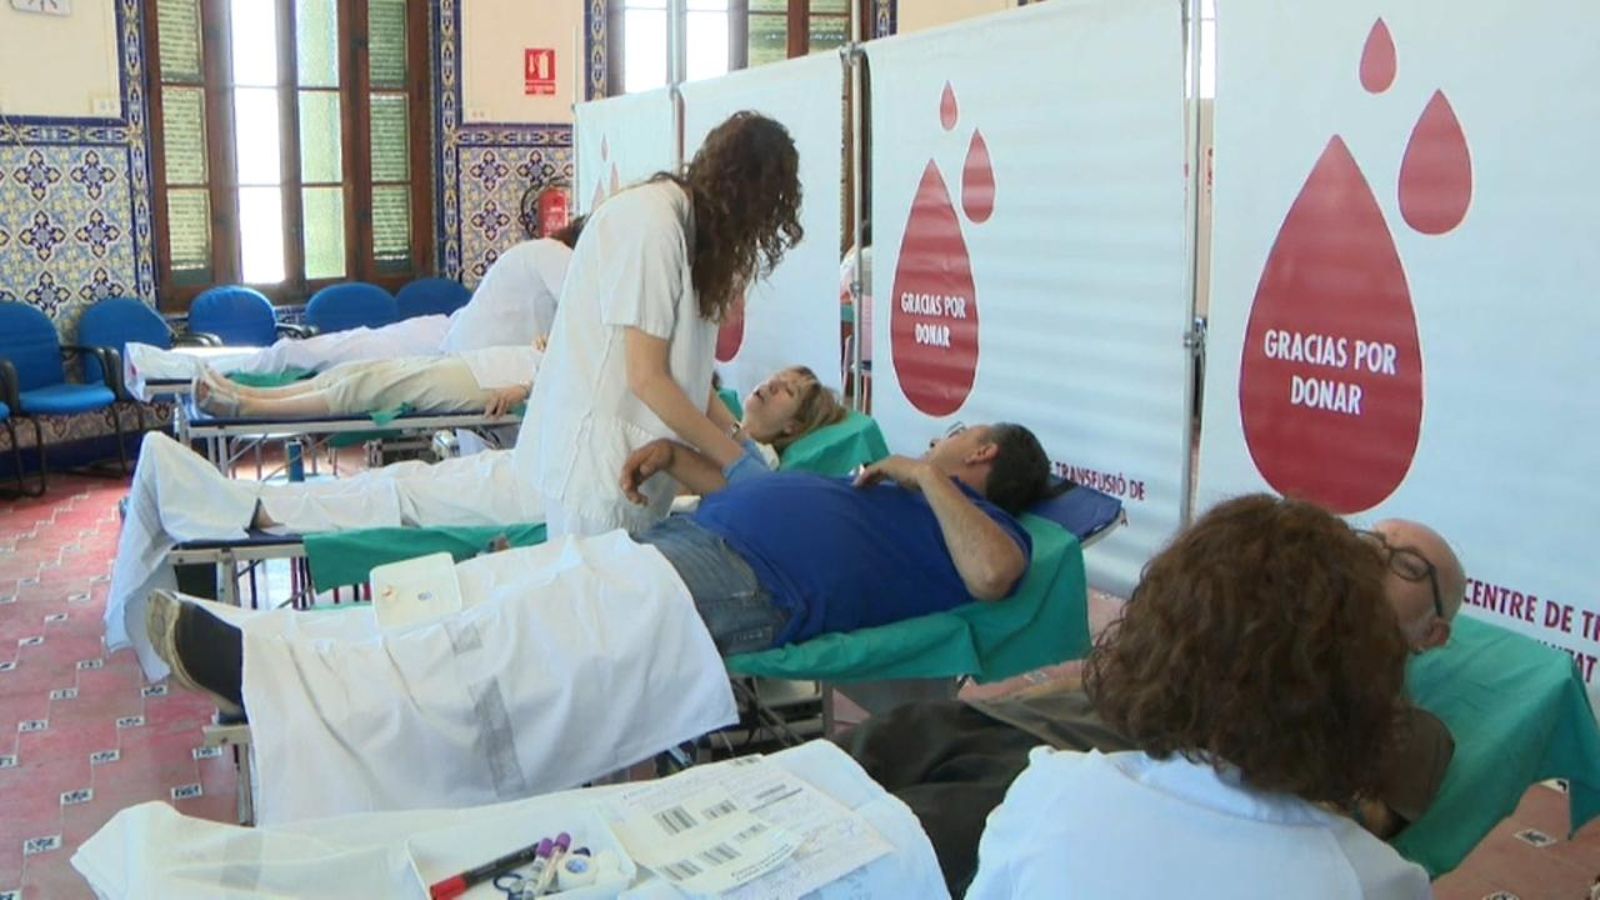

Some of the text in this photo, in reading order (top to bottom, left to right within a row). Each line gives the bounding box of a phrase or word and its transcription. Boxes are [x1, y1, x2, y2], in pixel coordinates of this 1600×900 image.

[901, 291, 966, 319] GRACIAS POR
[915, 323, 950, 348] DONAR
[1264, 328, 1397, 375] GRACIAS POR
[1290, 374, 1362, 415] DONAR
[1129, 479, 1145, 501] DE
[1463, 577, 1538, 623] CENTRE
[1543, 600, 1575, 633] DE
